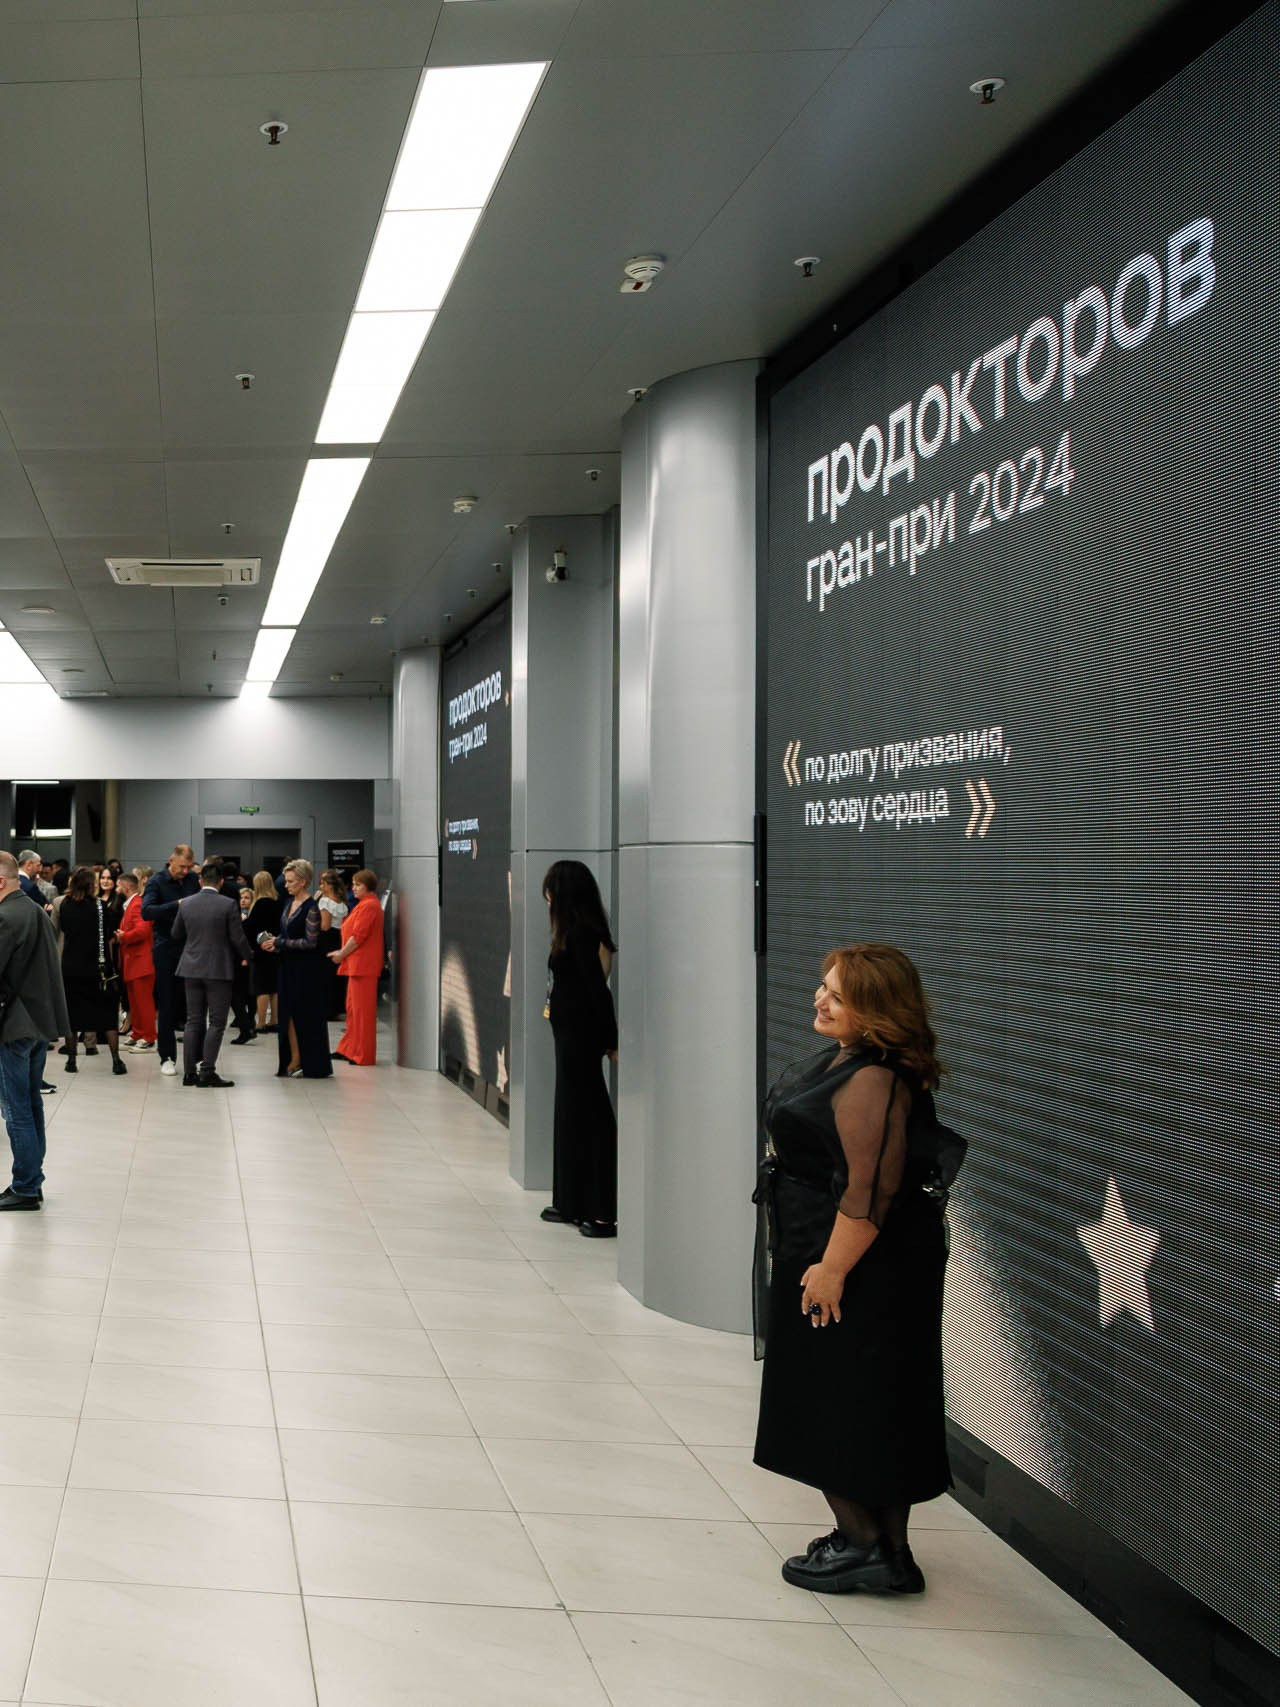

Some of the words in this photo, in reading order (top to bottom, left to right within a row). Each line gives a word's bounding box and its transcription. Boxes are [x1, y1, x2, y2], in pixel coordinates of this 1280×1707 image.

[807, 217, 1216, 523] продокторов
[807, 491, 956, 612] гран-при
[969, 431, 1076, 535] 2024
[449, 671, 502, 729] продокторов
[473, 722, 487, 749] 2024
[805, 757, 825, 782] по
[827, 747, 879, 784] долгу
[883, 726, 1011, 779] призвания,
[805, 800, 825, 825] по
[828, 796, 869, 832] зову
[872, 788, 950, 830] сердца
